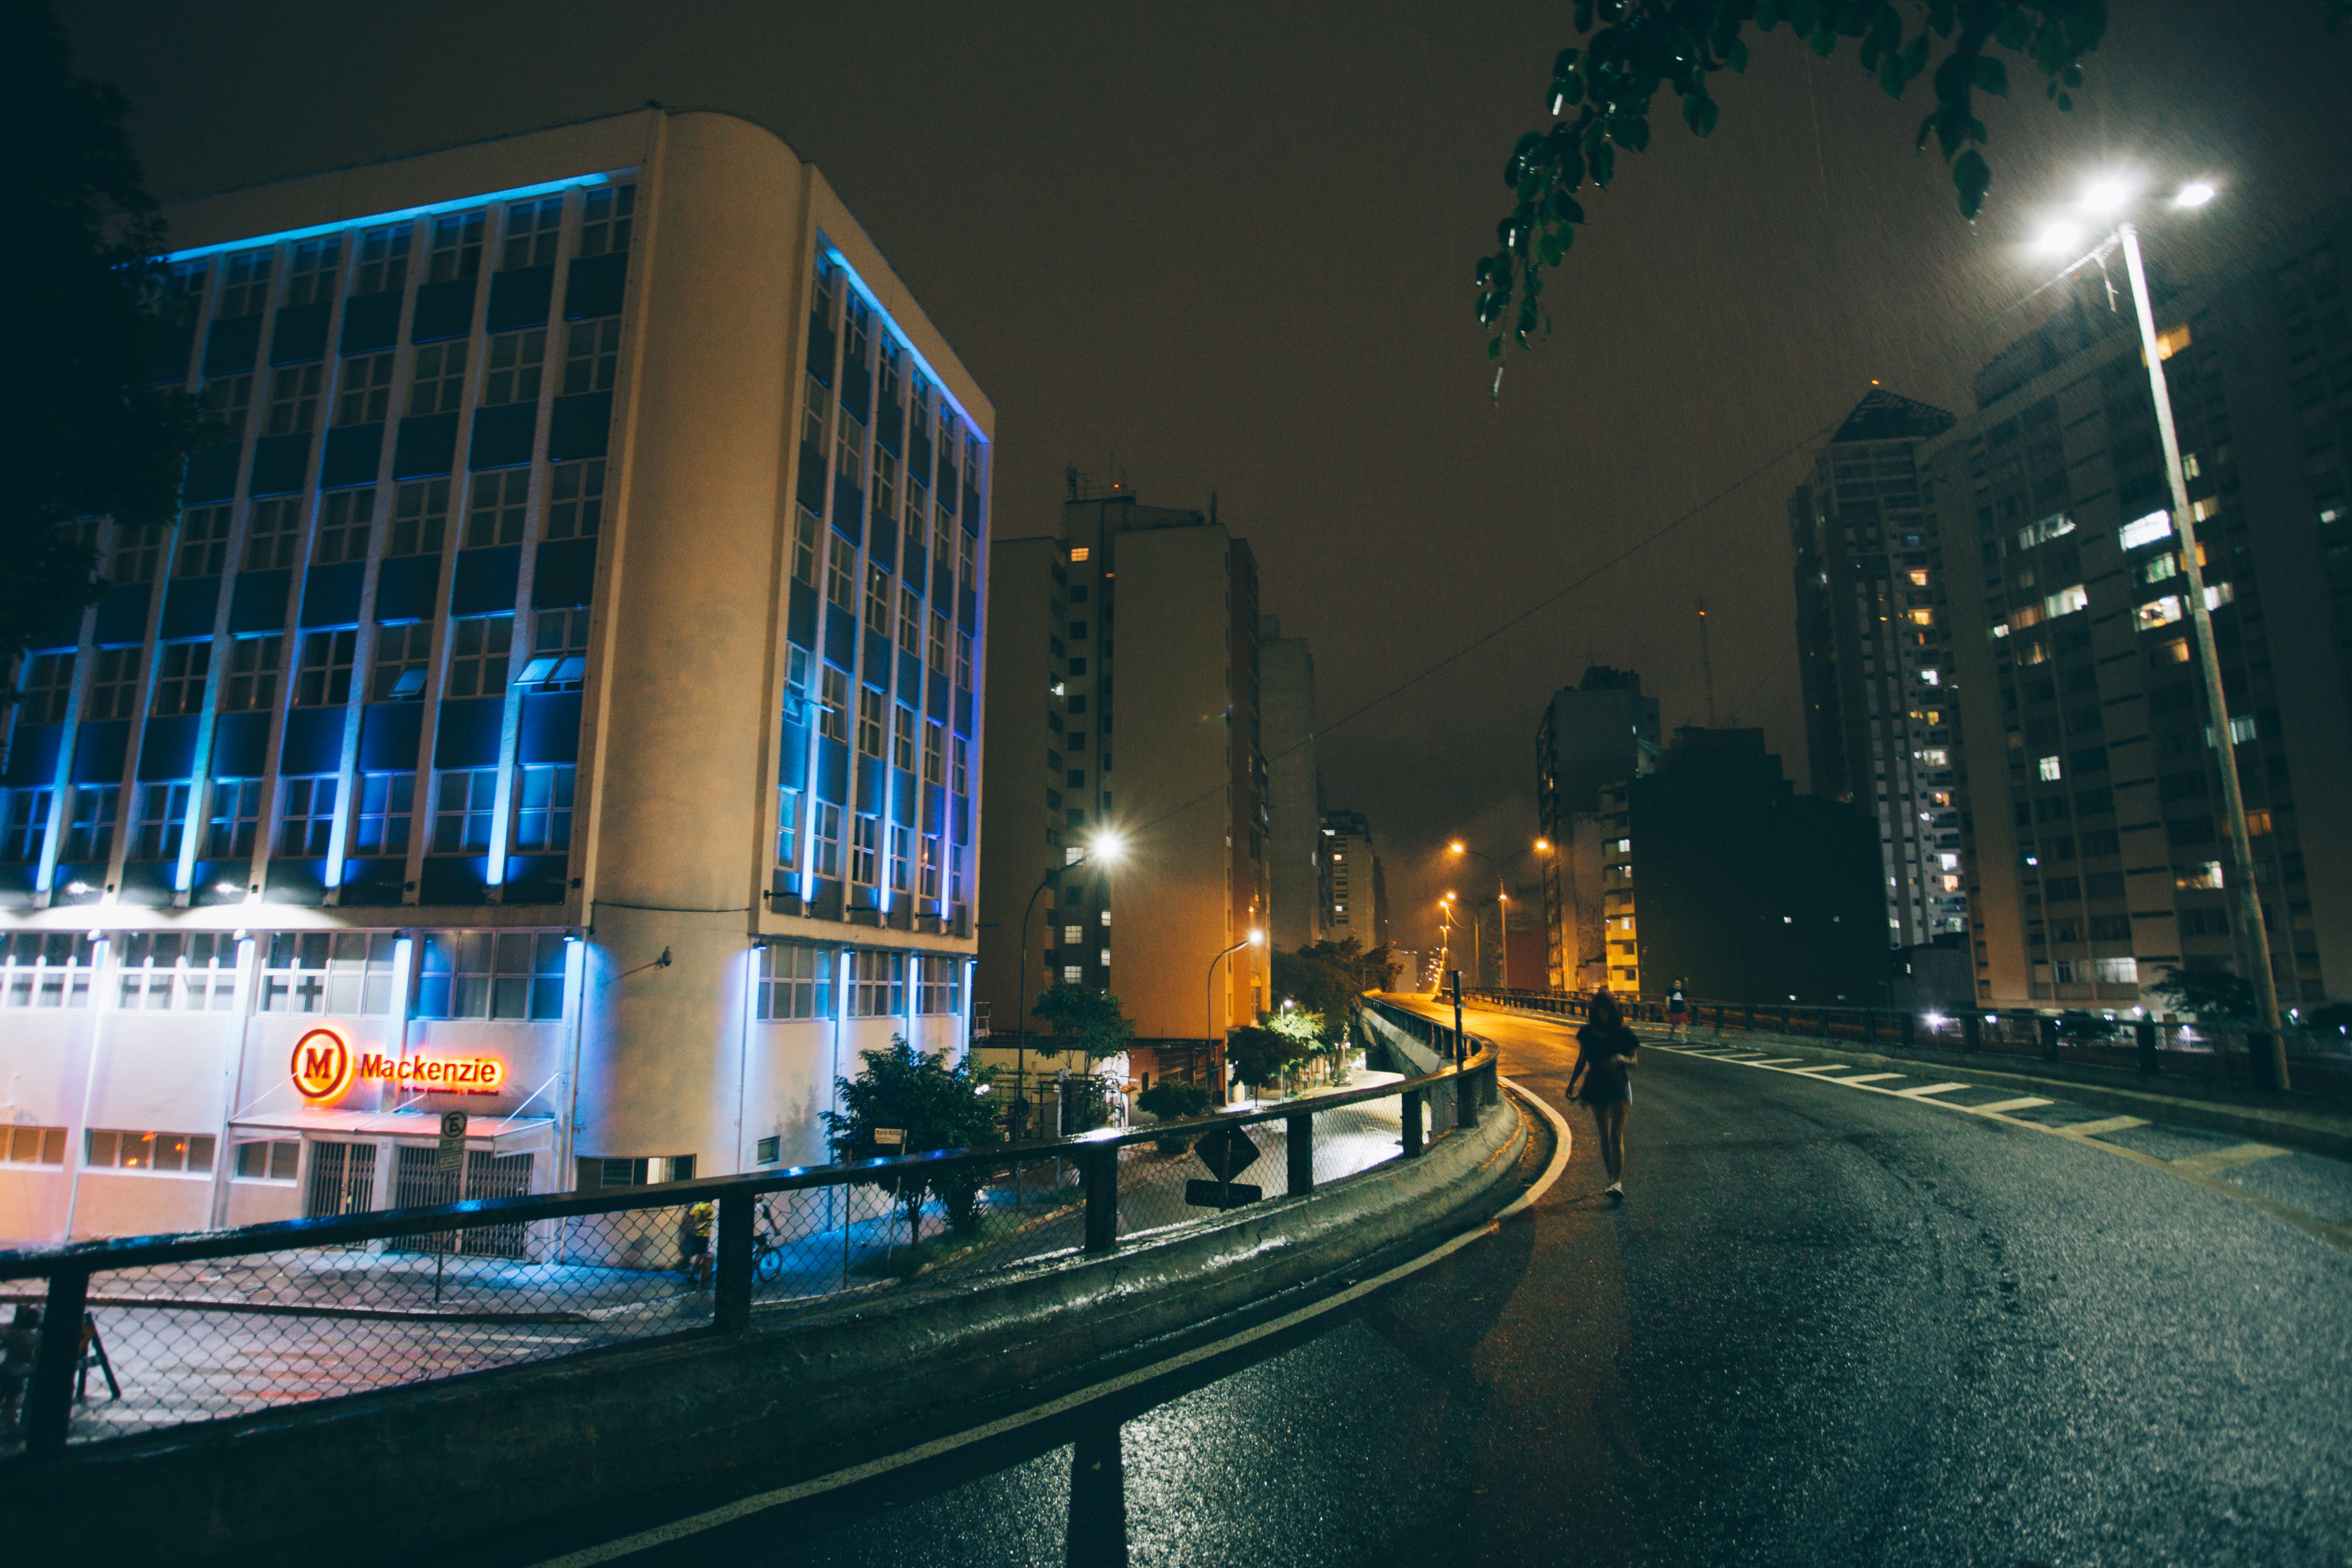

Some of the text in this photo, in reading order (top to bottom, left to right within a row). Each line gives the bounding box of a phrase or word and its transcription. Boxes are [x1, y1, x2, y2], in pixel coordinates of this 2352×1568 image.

[304, 1048, 496, 1083] M Mackenzie
[449, 1117, 459, 1133] E
